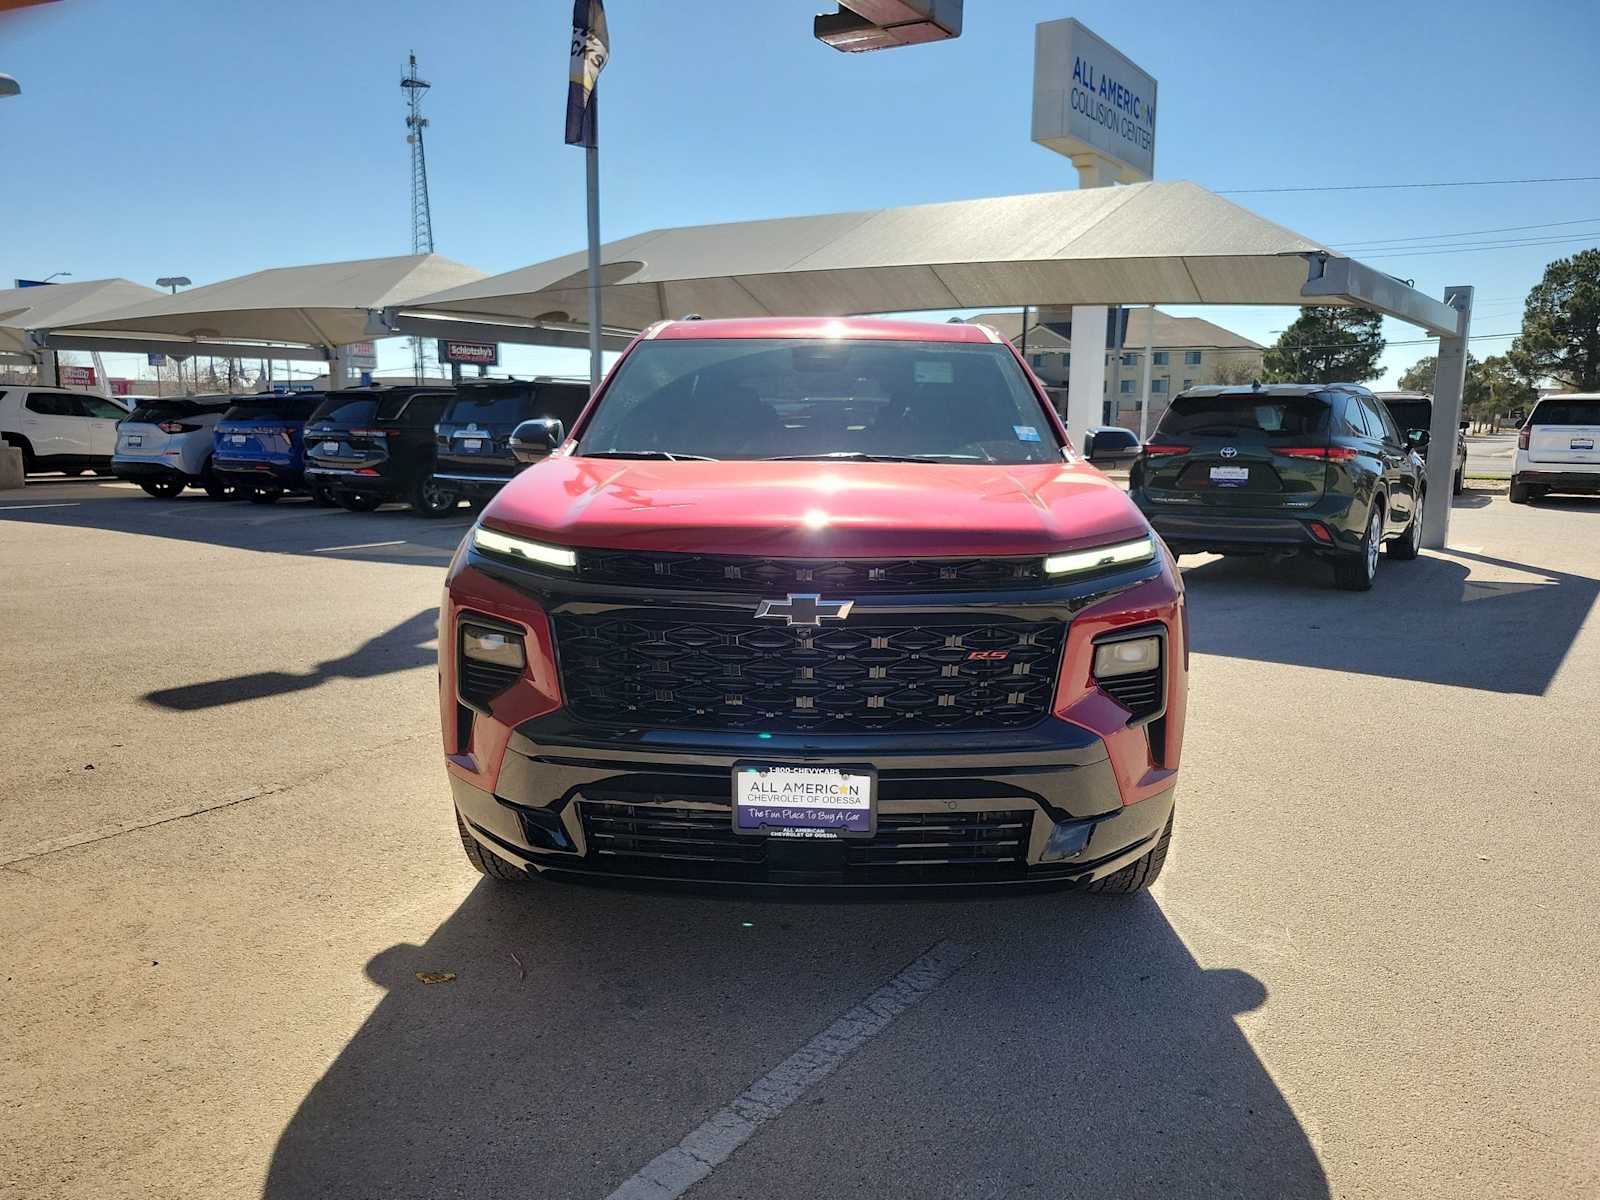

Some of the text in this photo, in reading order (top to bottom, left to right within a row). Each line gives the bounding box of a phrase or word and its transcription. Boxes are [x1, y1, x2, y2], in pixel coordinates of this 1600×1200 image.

[1073, 56, 1152, 127] ALL AMERICN
[1071, 87, 1152, 153] COLLISION CENTER
[967, 650, 1009, 661] RS
[750, 782, 859, 796] ALL AMERICN
[747, 793, 861, 805] CHEVROLET OF ODESSA
[748, 808, 860, 824] The Fun Place To Buy A Car
